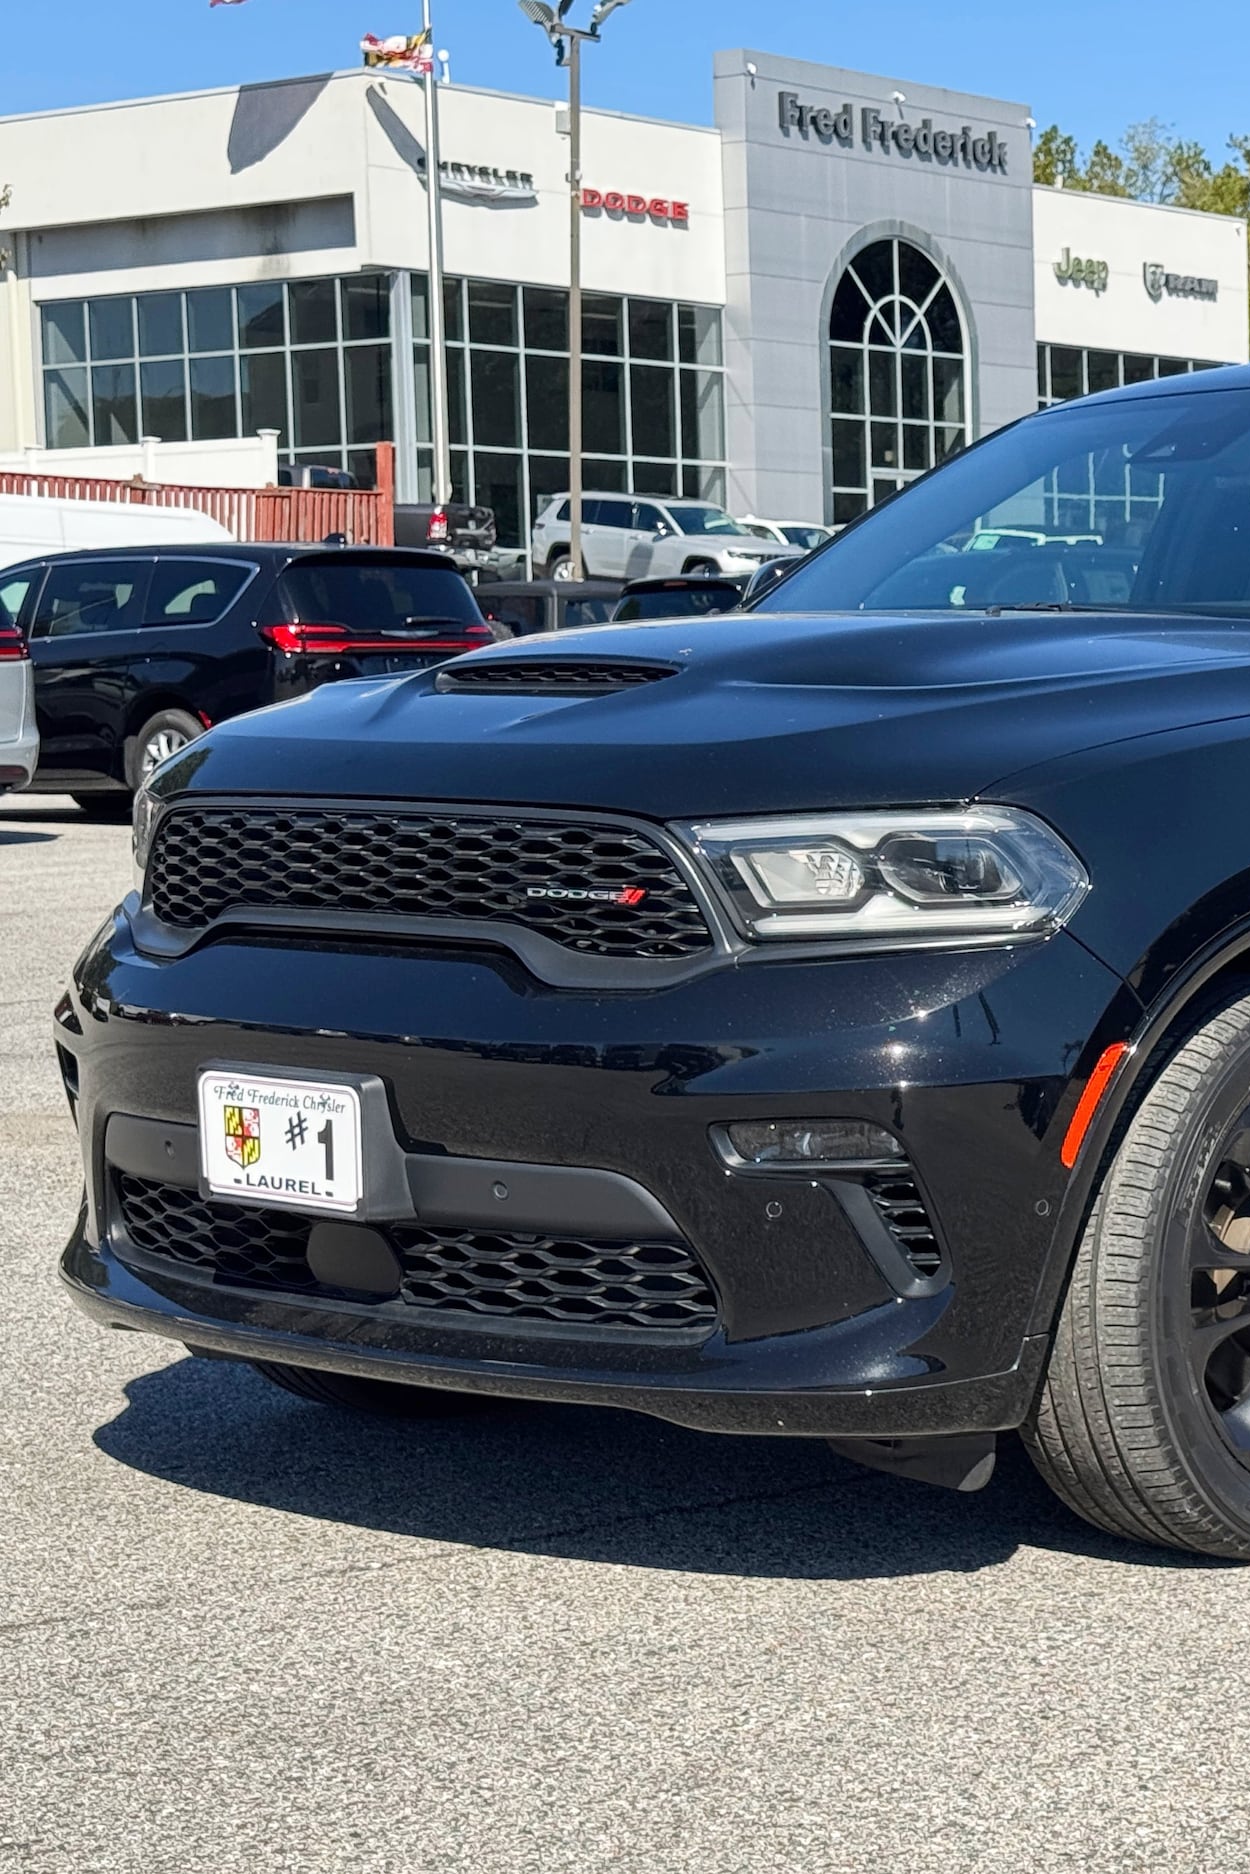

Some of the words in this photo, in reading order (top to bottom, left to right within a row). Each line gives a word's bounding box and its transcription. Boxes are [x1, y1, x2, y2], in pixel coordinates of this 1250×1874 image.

[779, 91, 853, 146] Fred
[861, 107, 1008, 170] Frederick
[581, 188, 689, 220] DODGE
[1052, 247, 1108, 298] Jeep
[1166, 273, 1218, 296] RAM
[527, 887, 630, 903] DODGE
[213, 1084, 244, 1102] Fred
[247, 1088, 300, 1109] Frederick
[302, 1094, 347, 1116] Chrysler
[246, 1173, 322, 1196] LAUREL
